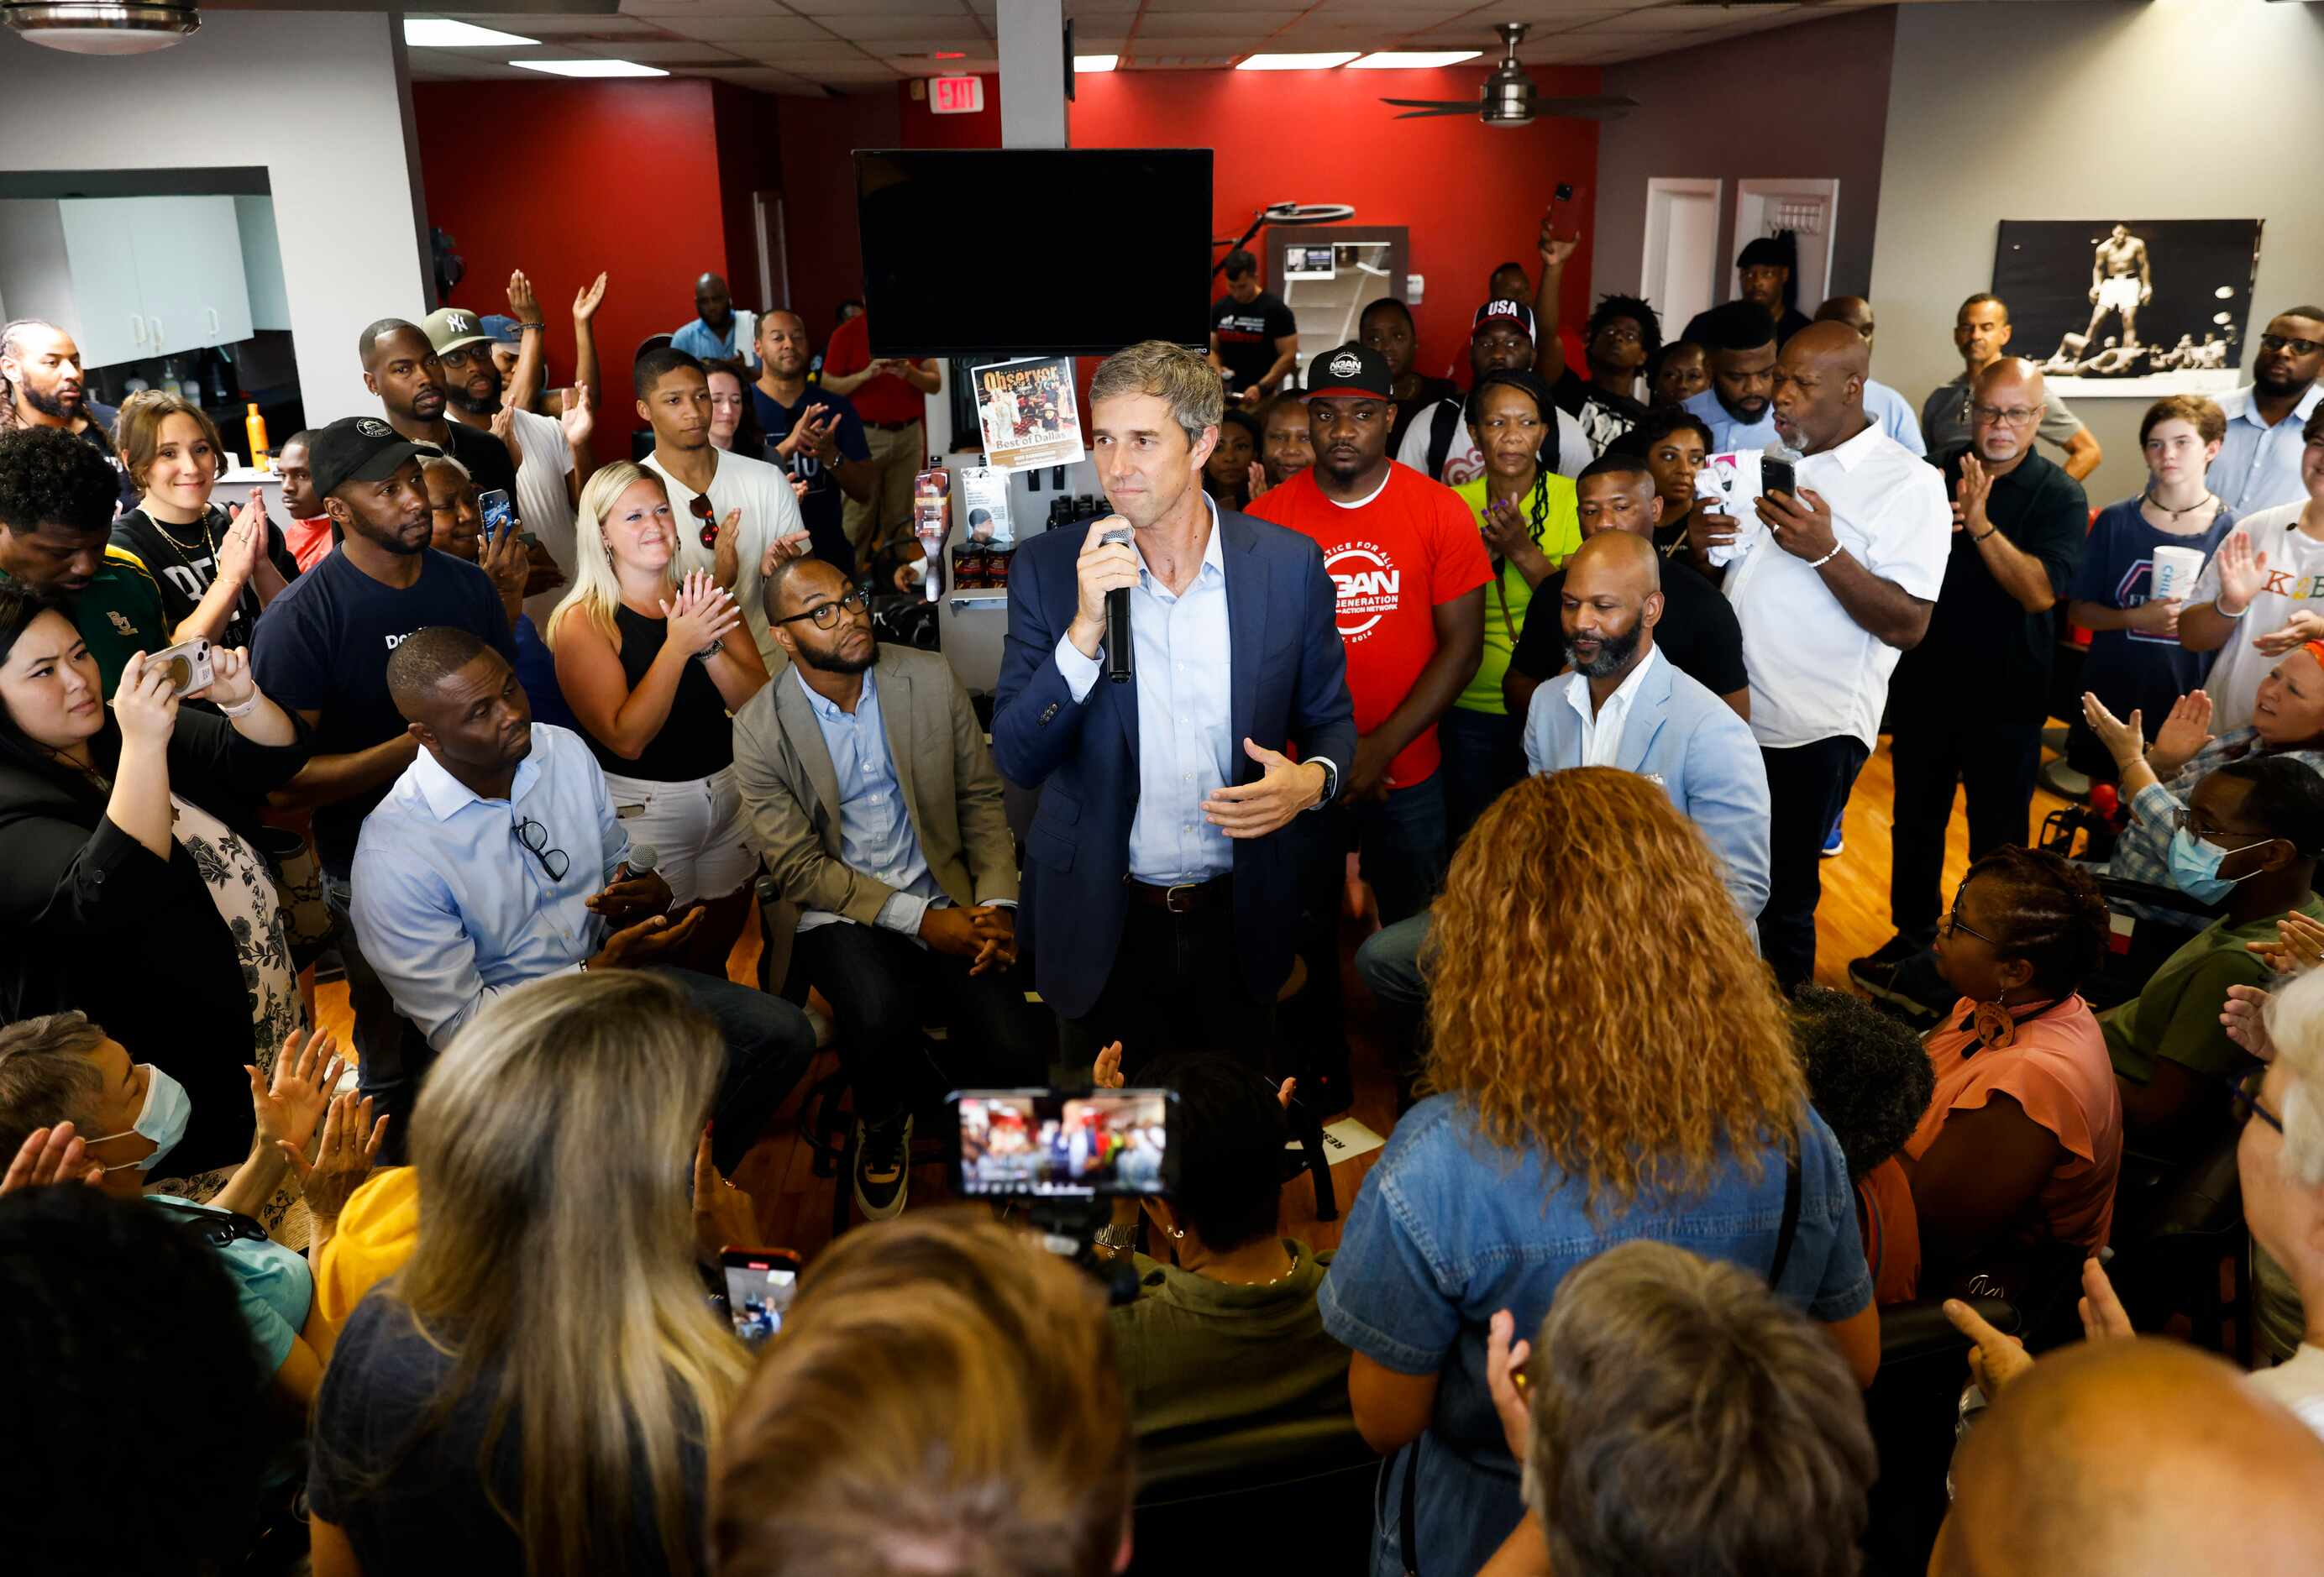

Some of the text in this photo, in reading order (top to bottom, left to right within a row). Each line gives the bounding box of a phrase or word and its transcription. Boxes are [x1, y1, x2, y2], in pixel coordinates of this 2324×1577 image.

[937, 79, 974, 111] EXIT
[1488, 300, 1518, 317] USA
[447, 313, 469, 332] NY
[1330, 360, 1361, 371] NGAN
[996, 439, 1019, 449] Best
[1022, 436, 1033, 444] of
[1034, 431, 1067, 443] Dallas
[1324, 541, 1394, 570] TICE FOR ALL
[1329, 570, 1400, 598] GAN
[1366, 604, 1398, 612] NETWORK
